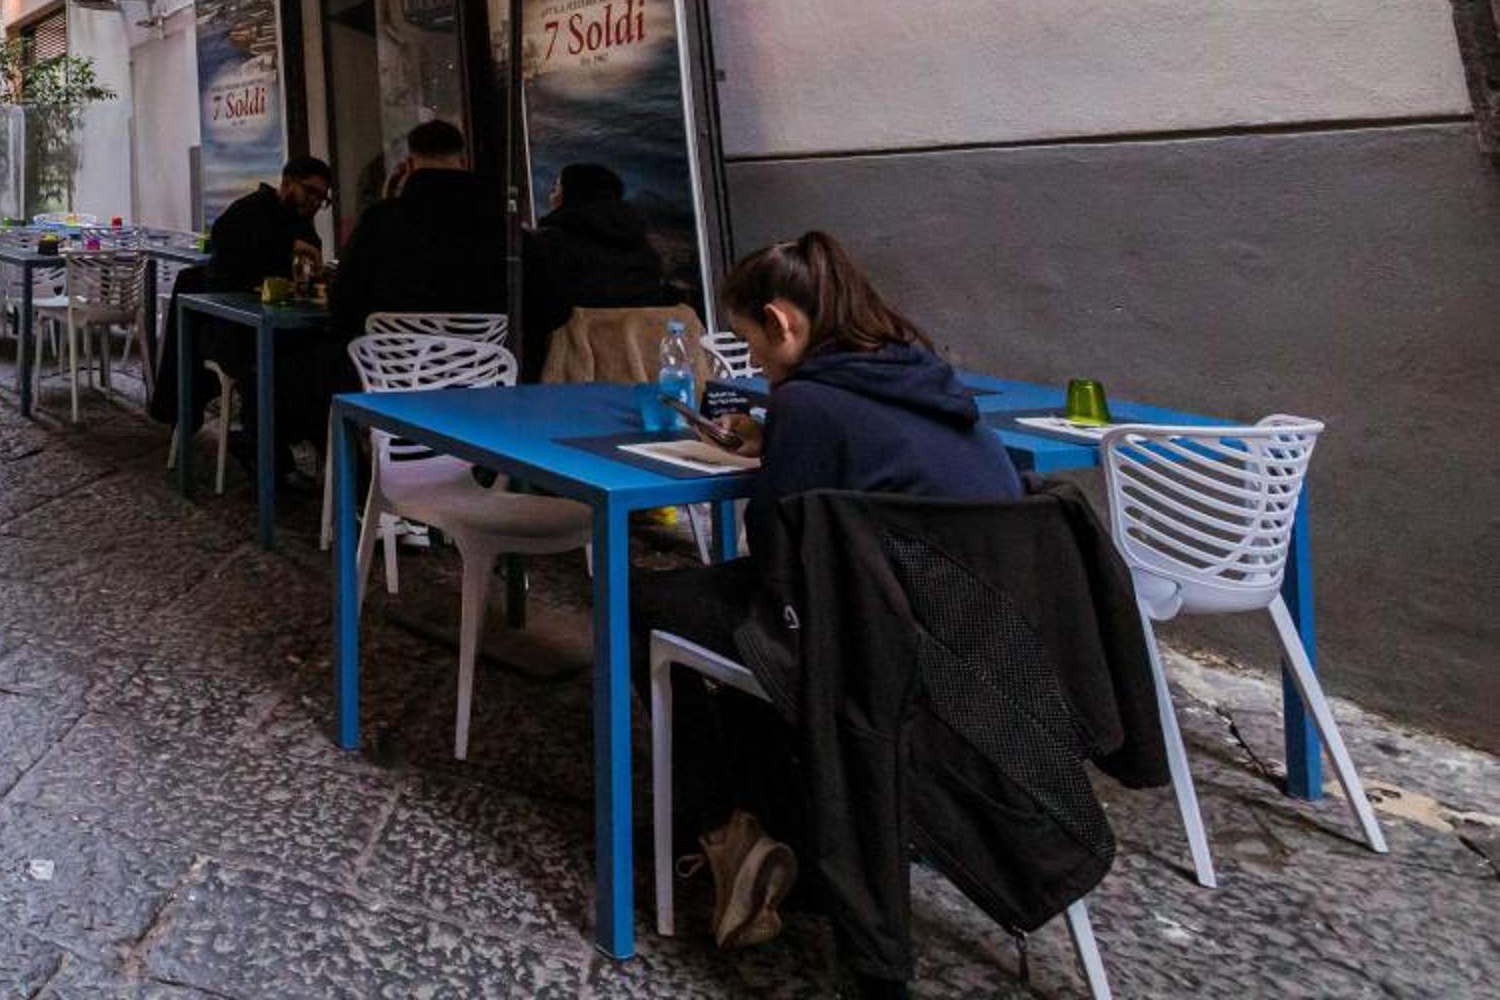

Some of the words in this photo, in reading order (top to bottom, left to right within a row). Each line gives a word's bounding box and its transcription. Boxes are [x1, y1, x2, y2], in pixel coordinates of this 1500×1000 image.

[545, 21, 559, 62] 7
[213, 95, 222, 120] 7
[226, 87, 265, 119] Soldi
